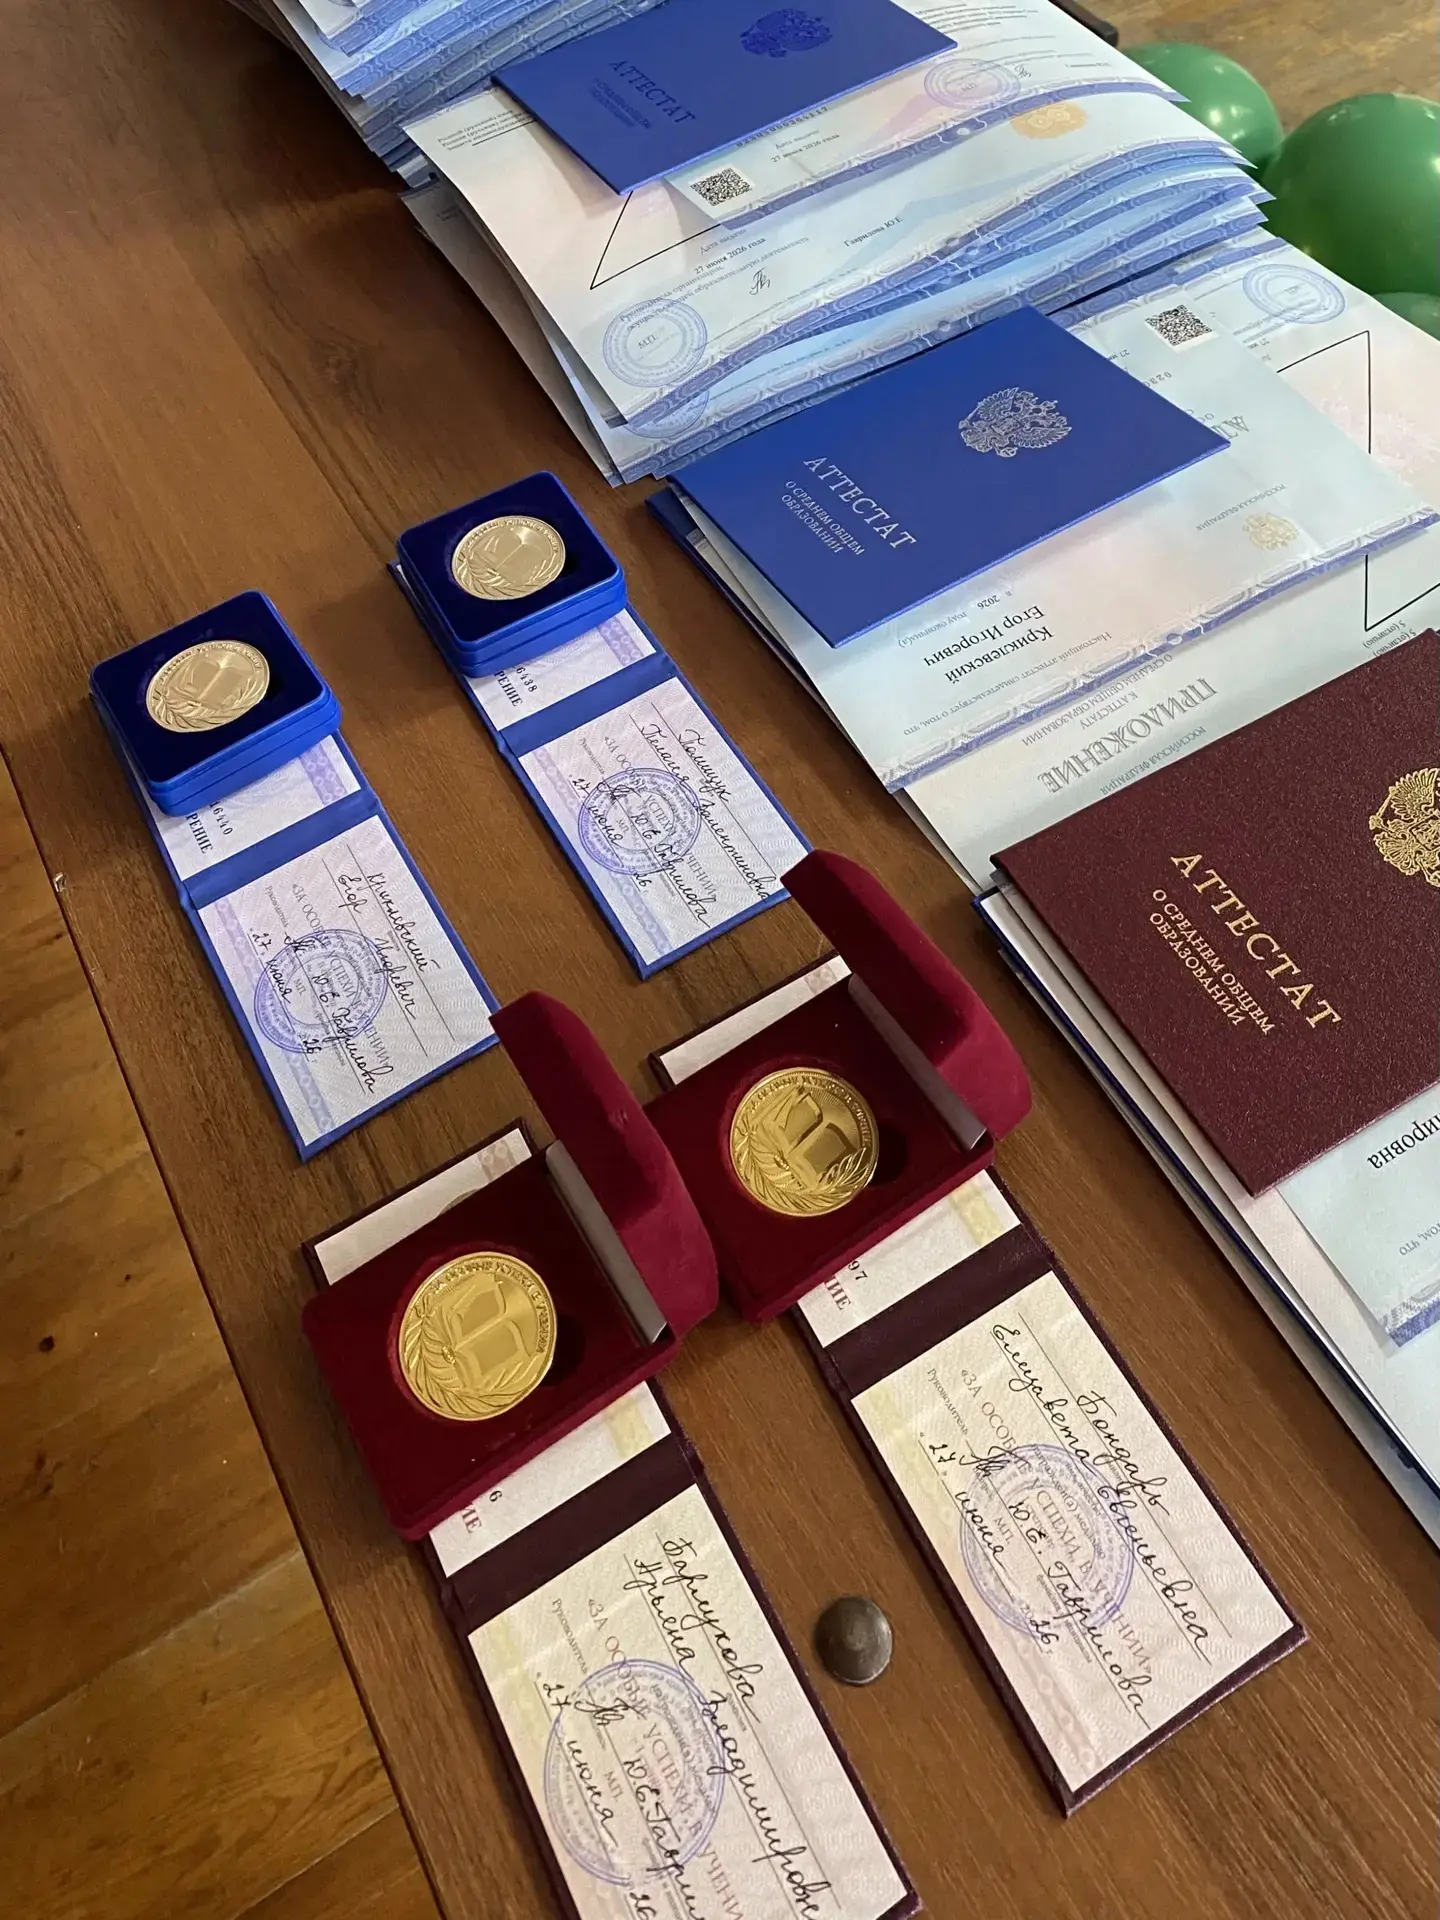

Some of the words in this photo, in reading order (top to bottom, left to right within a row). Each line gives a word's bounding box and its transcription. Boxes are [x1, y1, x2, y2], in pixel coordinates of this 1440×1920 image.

[608, 60, 696, 123] АТТЕСТАТ
[771, 155, 781, 163] 27
[802, 140, 821, 151] 2026
[693, 265, 705, 275] 27
[704, 255, 728, 270] июня
[727, 246, 748, 260] 2026
[747, 236, 766, 249] года
[844, 226, 885, 247] Гаврилова
[785, 480, 797, 489] О
[792, 487, 833, 525] СРЕДНЕМ
[829, 523, 865, 555] ОБЩЕМ
[803, 456, 917, 549] АТТЕСТАТ
[781, 494, 845, 553] ОБРАЗОВАНИИ
[977, 595, 1000, 609] 2026
[1002, 605, 1046, 630] Егор
[923, 625, 1004, 667] Игоревич
[944, 625, 1055, 685] Криклевский
[1058, 631, 1113, 662] Настоящий
[516, 667, 537, 692] 6438
[1021, 656, 1059, 680] аттестат
[1125, 658, 1166, 690] СРЕДНЕМ
[949, 674, 1021, 714] свидетельствует
[1079, 695, 1134, 731] АТТЕСТАТУ
[1089, 682, 1125, 708] ОБЩЕМ
[903, 723, 921, 736] что
[1021, 701, 1091, 748] ОБРАЗОВАНИИ
[1037, 677, 1218, 793] ПРИЛОЖЕНИЕ
[1150, 726, 1207, 765] РОССИЙСКАЯ
[1099, 760, 1150, 796] ФЕДЕРАЦИЯ
[186, 813, 213, 854] РЕНИЕ
[1170, 854, 1342, 1029] АТТЕСТАТ
[1149, 912, 1246, 1026] ОБРАЗОВАНИИ
[1152, 889, 1167, 902] О
[1163, 903, 1226, 973] СРЕДНЕМ
[1221, 973, 1276, 1036] ОБЩЕМ
[1399, 1239, 1420, 1257] что
[926, 1367, 969, 1436] Руководитель
[489, 1490, 503, 1503] 6
[552, 1597, 588, 1674] Руководитель
